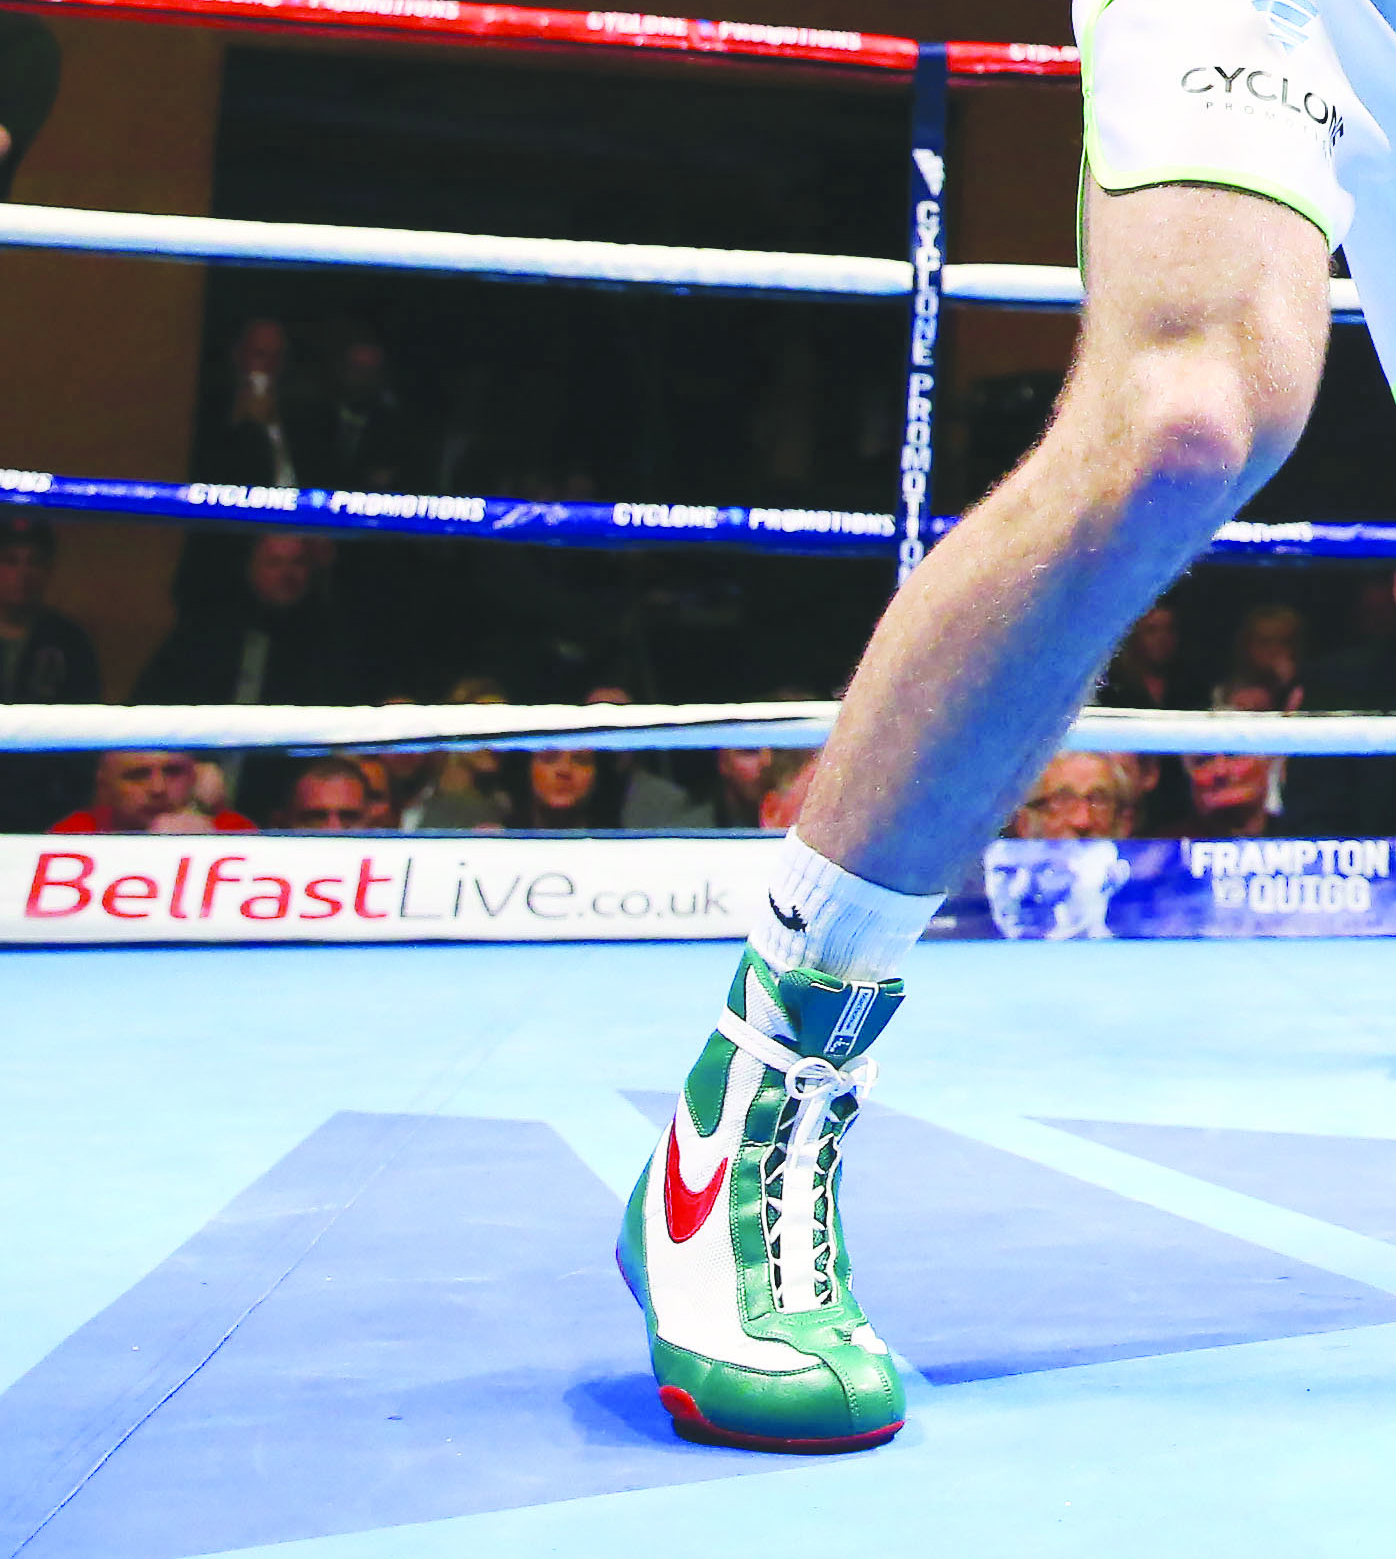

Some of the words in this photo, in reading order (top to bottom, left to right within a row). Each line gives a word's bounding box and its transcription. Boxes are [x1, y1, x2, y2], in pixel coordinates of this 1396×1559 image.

[189, 482, 298, 512] CYCLONE
[330, 489, 487, 523] PROMOTIONS
[613, 502, 718, 530] CYCLONE
[1191, 840, 1389, 879] FRAMPTON
[24, 852, 731, 922] BelfastLive.co.uk
